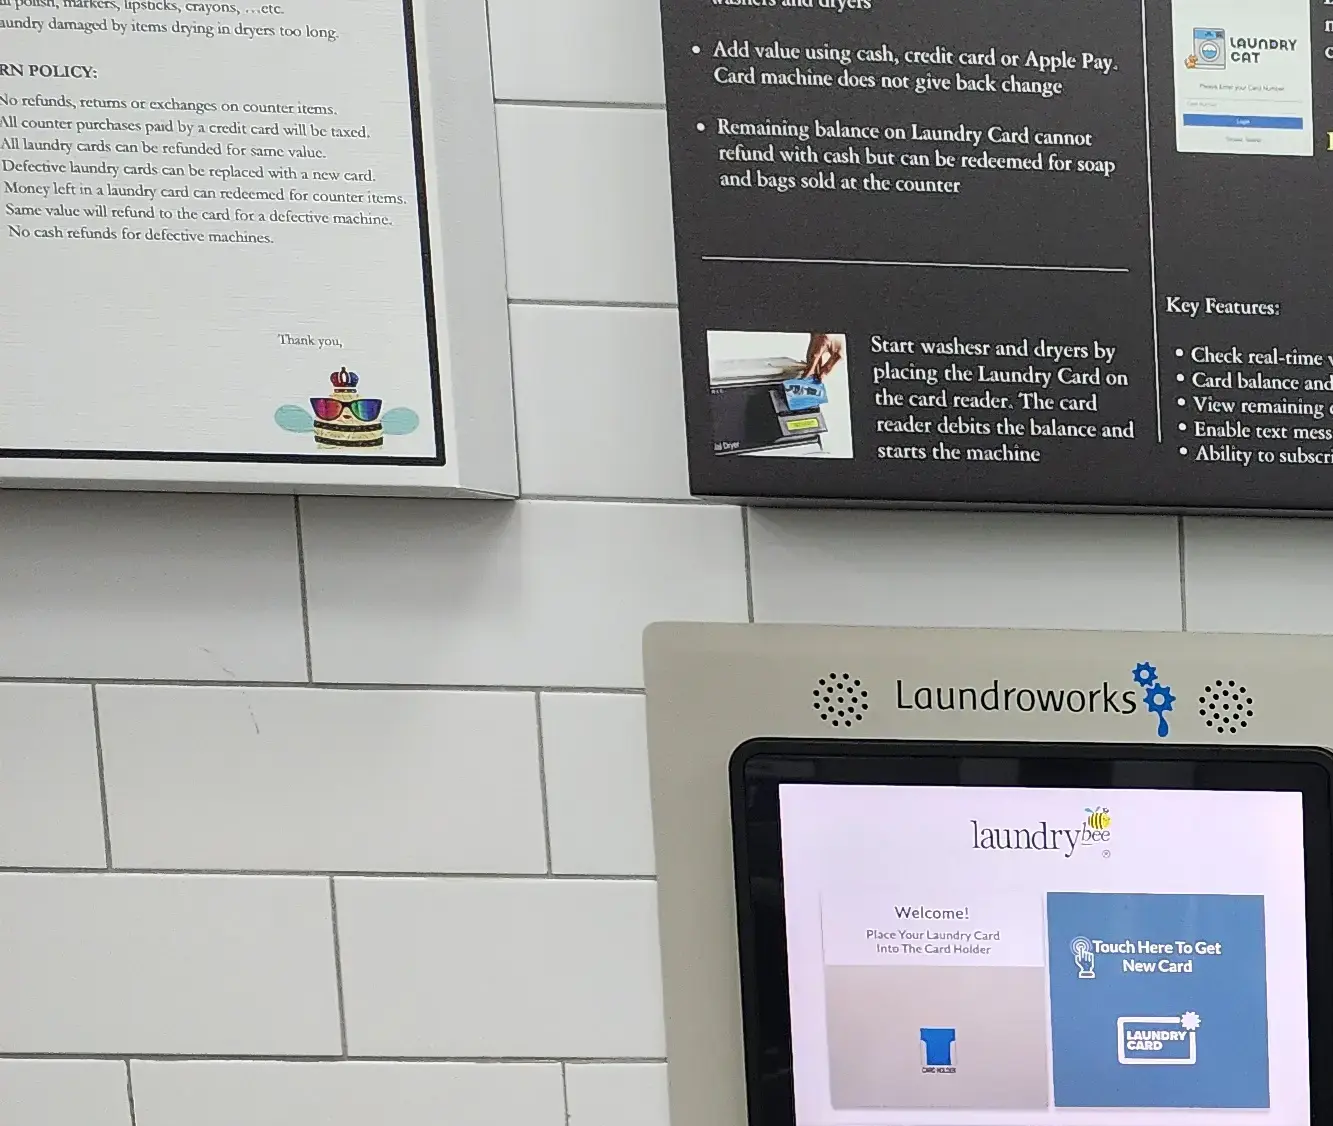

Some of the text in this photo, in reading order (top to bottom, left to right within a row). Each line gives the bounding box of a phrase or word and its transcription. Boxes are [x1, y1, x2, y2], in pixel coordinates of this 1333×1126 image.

[1230, 37, 1297, 51] LAUNDRY
[713, 40, 1118, 74] Add value using cash, credit card or Apple Pay.
[1231, 52, 1260, 63] CAT
[28, 65, 97, 78] POLICY:
[2, 159, 66, 173] Defective
[69, 161, 119, 178] laundry
[123, 163, 158, 175] cards
[162, 167, 185, 176] can
[188, 164, 205, 176] be
[209, 165, 264, 181] replaced
[268, 166, 297, 179] with
[313, 172, 340, 180] new
[344, 169, 375, 181] card.
[1166, 297, 1279, 317] Key Features:
[278, 334, 342, 349] Thank you,
[872, 336, 914, 353] Start
[996, 339, 1028, 356] and
[1034, 340, 1088, 362] dryers
[1094, 341, 1115, 363] by
[1191, 346, 1243, 363] Check
[1248, 348, 1323, 365] real-time
[896, 679, 1138, 714] Laundroworks
[894, 906, 969, 919] Welcome!
[1092, 940, 1221, 954] Touch Here To Get
[1123, 959, 1192, 972] New Card
